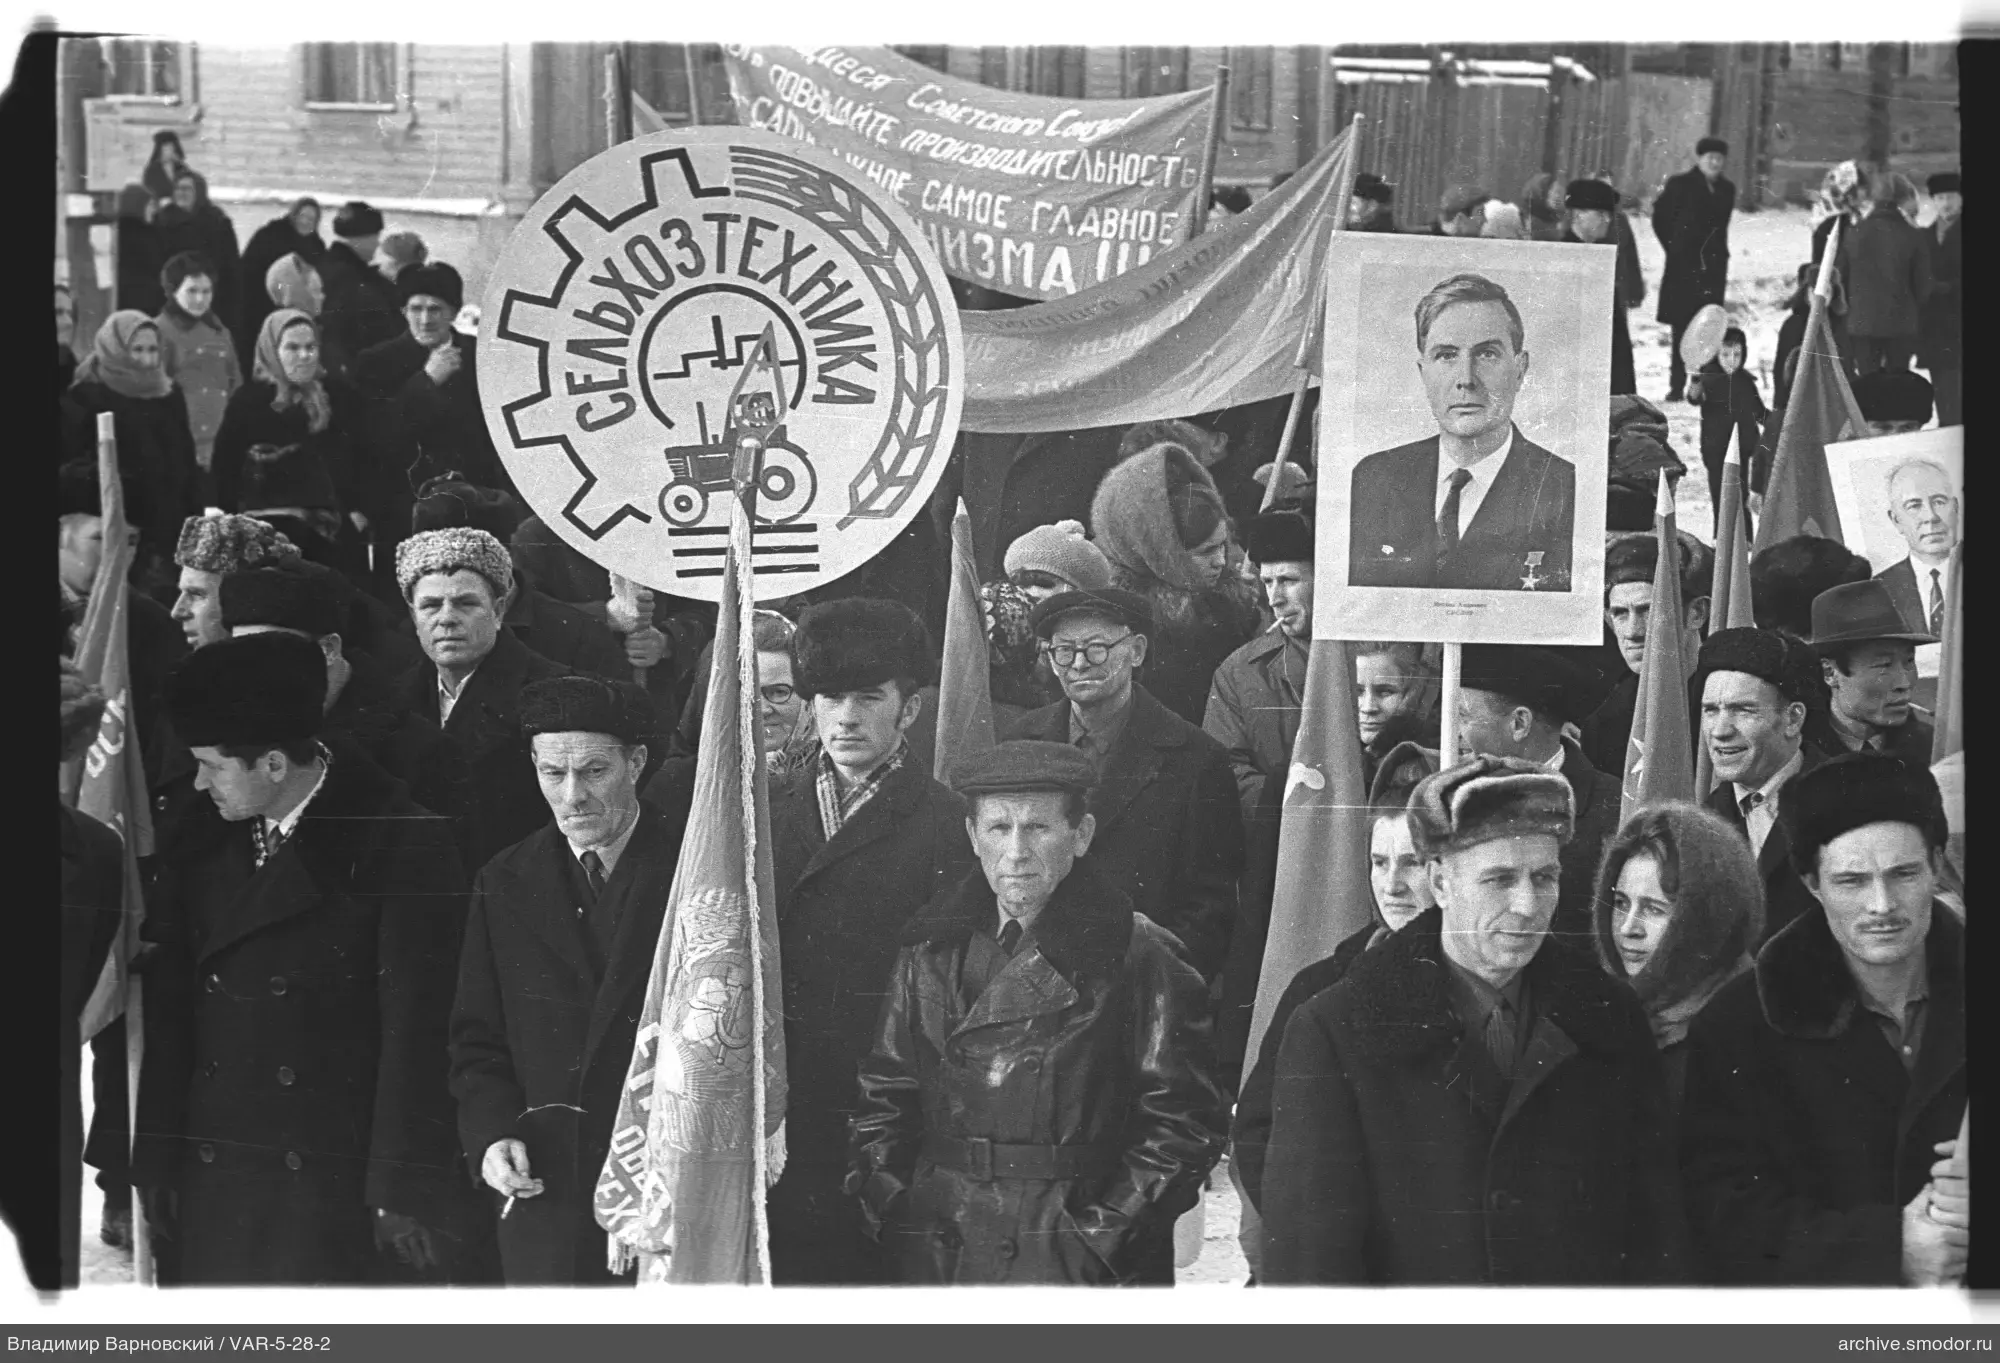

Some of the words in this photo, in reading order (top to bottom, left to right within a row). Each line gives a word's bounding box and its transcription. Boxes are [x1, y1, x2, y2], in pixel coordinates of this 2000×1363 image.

[900, 129, 1197, 189] ПРОИЗВОДИТЕЛЬНОСТЬ
[921, 179, 1012, 229] САМОЕ
[1031, 200, 1179, 245] ГЛАВНОЕ
[565, 213, 878, 432] СЕЛЬХОЗТЕХНИКА
